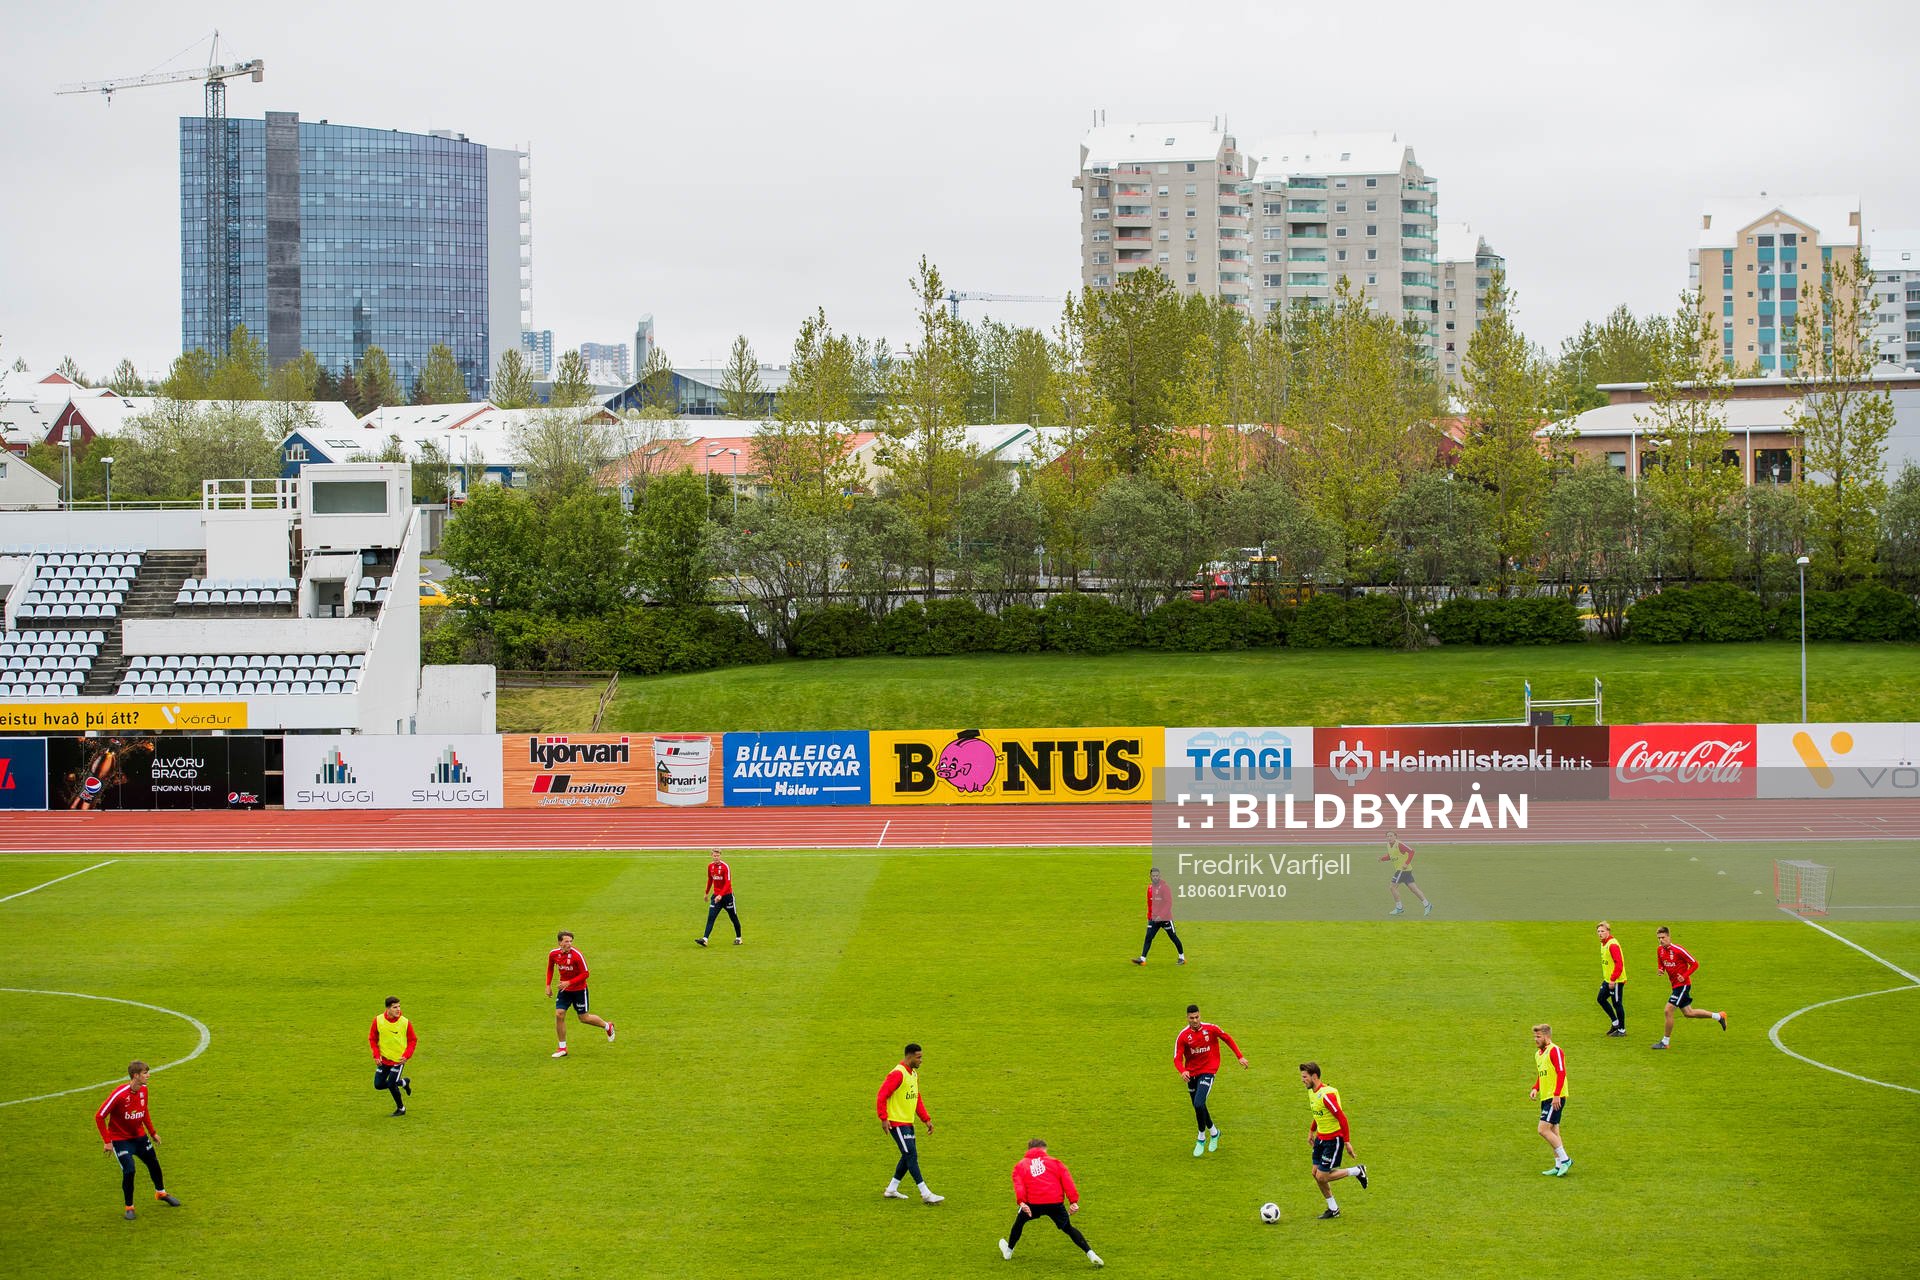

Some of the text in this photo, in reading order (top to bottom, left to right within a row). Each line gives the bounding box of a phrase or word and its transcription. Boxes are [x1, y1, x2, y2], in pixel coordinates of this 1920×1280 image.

[44, 712, 79, 725] hvað
[86, 712, 104, 727] þú
[111, 711, 139, 725] átt?
[181, 715, 232, 724] vörður
[530, 737, 629, 768] kjörvari
[736, 743, 857, 761] BÍLALEIGA
[151, 757, 204, 768] ALVÖRU
[894, 739, 1142, 792] BNUS
[1187, 748, 1292, 781] TENGI
[1380, 749, 1592, 772] Heimilistæki ht.is
[1616, 740, 1751, 783] Coca-Cola
[151, 769, 198, 779] BRAGÐ
[733, 761, 860, 778] AKUREYRAR
[297, 791, 374, 803] SKUGGI
[411, 790, 489, 802] SKUGGI
[568, 783, 626, 795] málning
